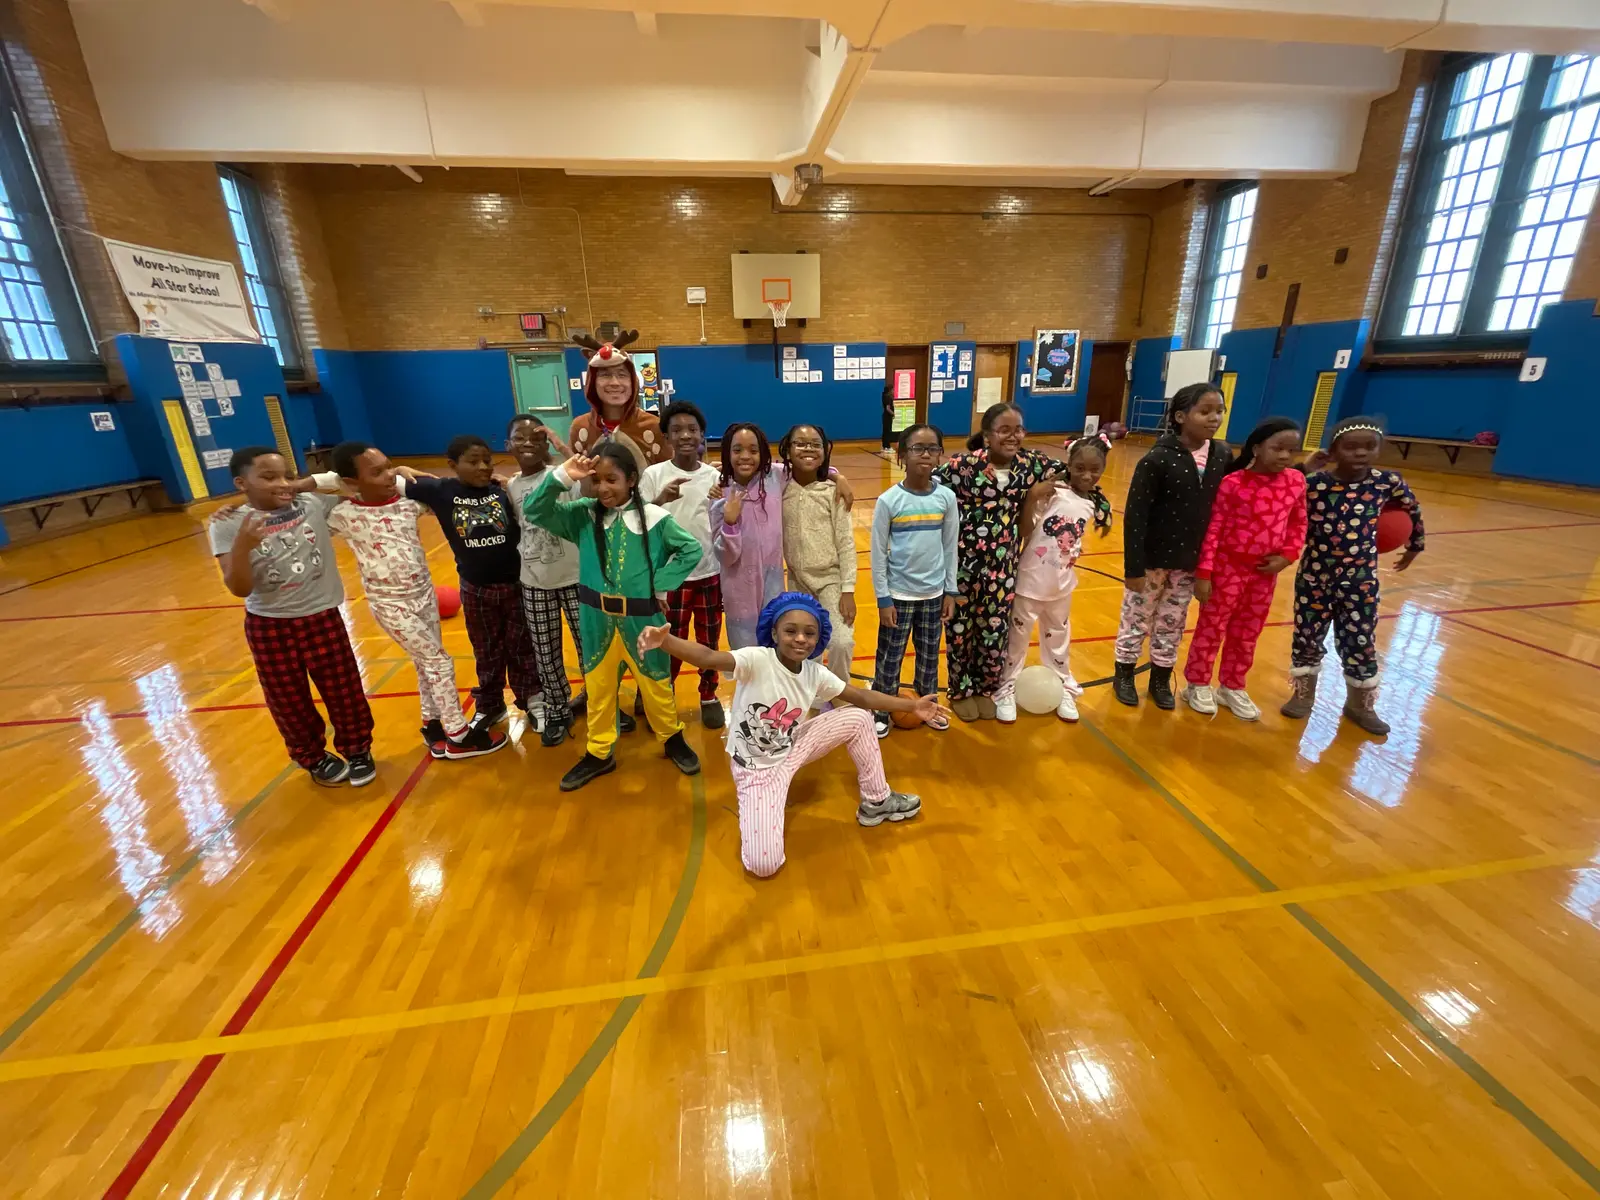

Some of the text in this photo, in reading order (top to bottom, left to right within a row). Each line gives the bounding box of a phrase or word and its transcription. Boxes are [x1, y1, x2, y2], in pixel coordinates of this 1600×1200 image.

[132, 254, 221, 281] Move-to-Improve
[151, 277, 220, 297] All Star School
[1529, 364, 1538, 376] 5
[453, 493, 500, 506] GENIUS LEVEL
[464, 534, 506, 548] UNLOCKED
